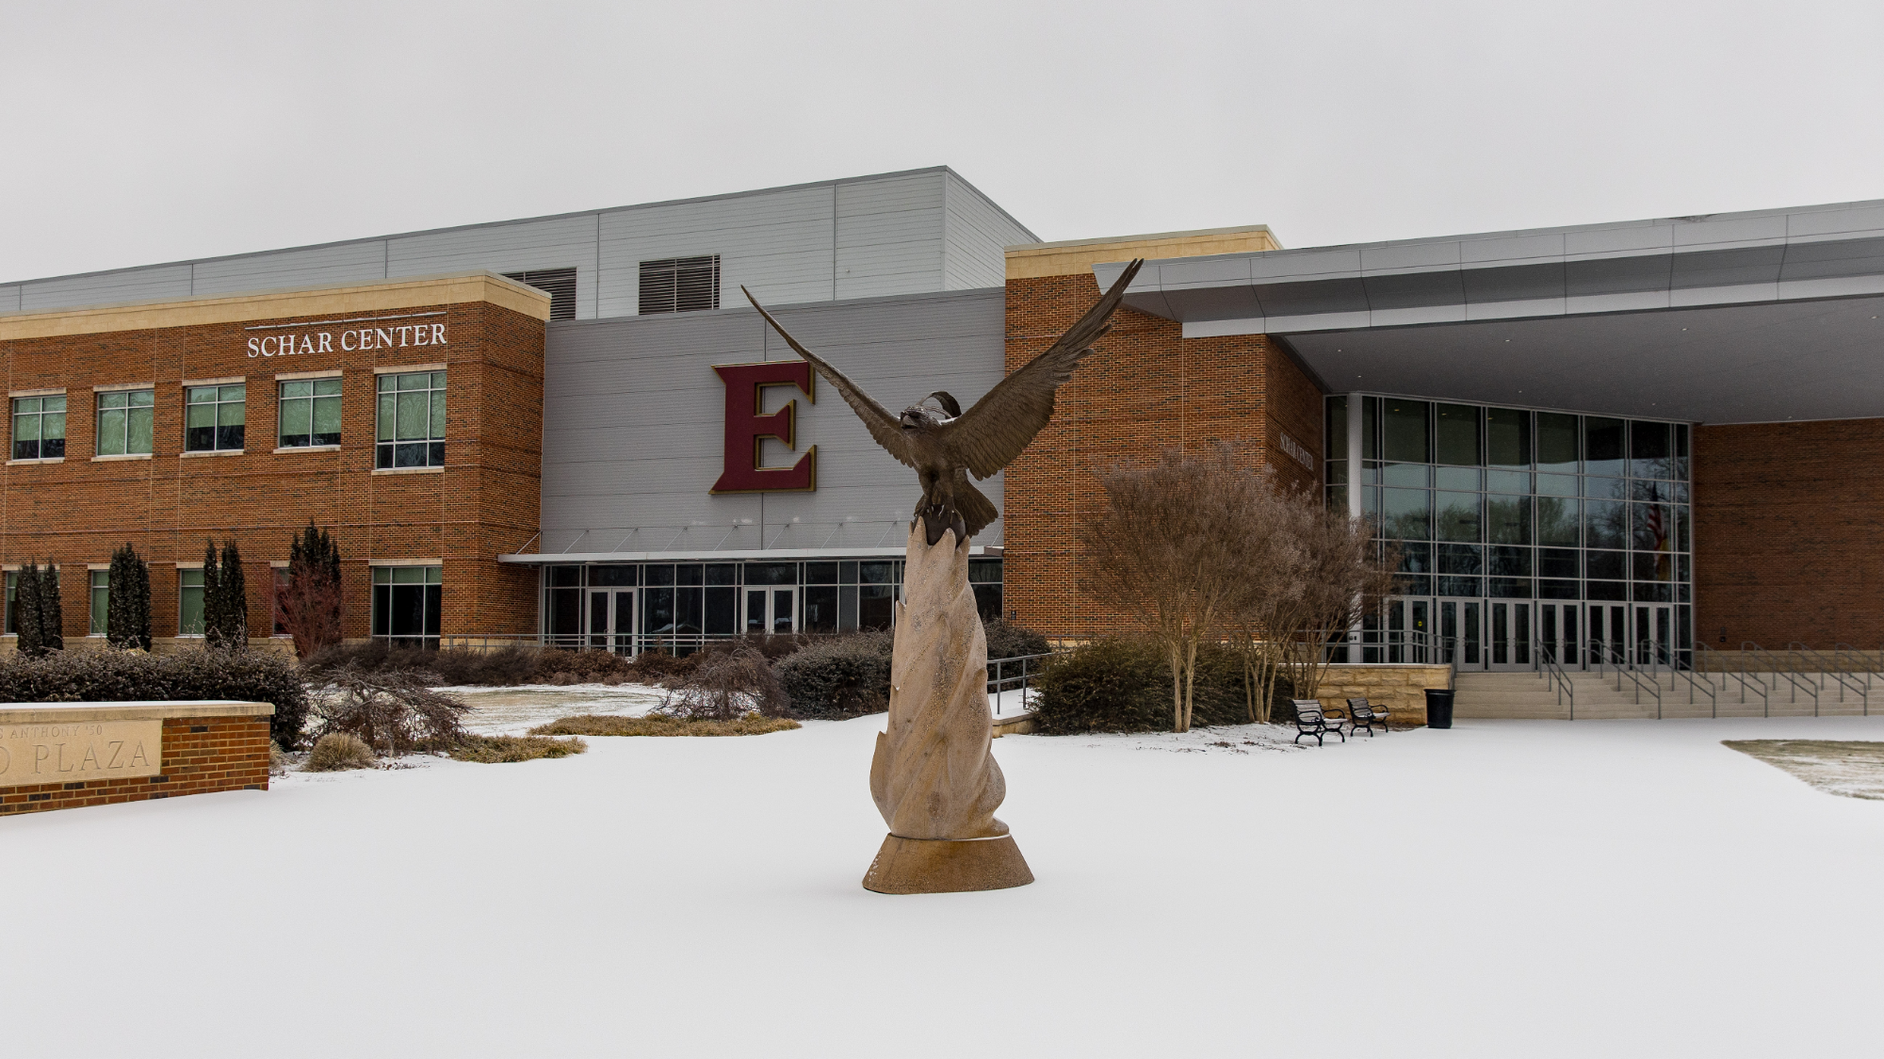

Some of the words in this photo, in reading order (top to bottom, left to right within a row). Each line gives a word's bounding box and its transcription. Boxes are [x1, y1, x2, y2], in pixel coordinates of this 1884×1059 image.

[247, 332, 334, 358] SCHAR
[341, 323, 447, 351] CENTER
[708, 359, 817, 495] E
[10, 725, 80, 739] ANTHONY
[85, 724, 103, 736] '50
[31, 740, 150, 775] PLAZA
